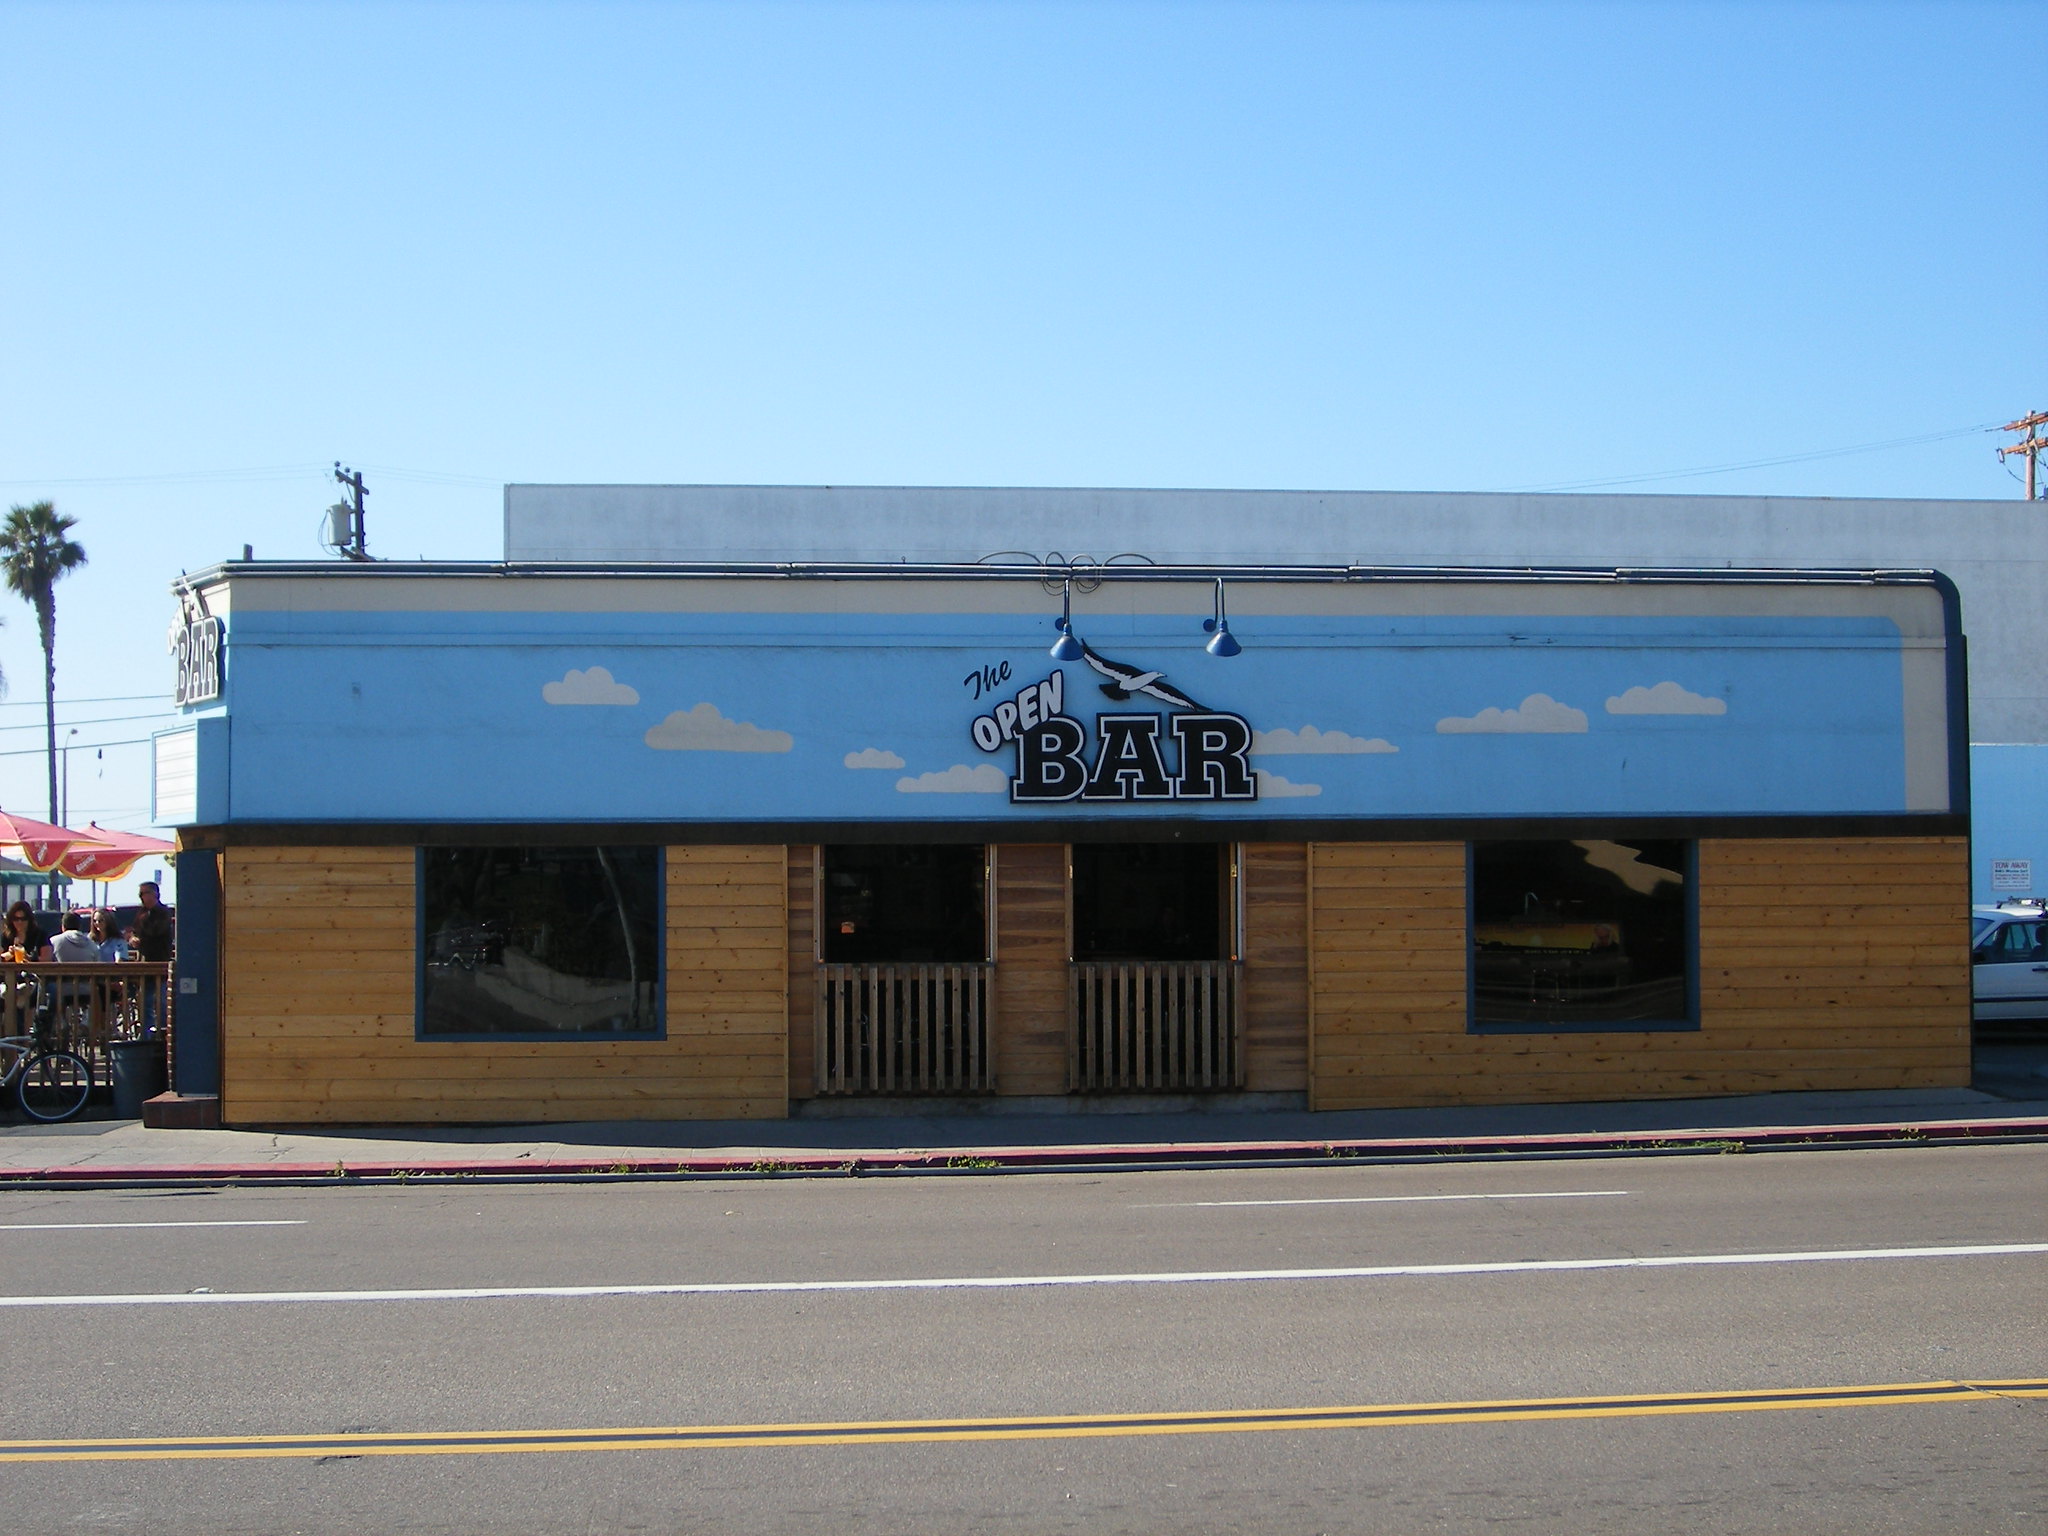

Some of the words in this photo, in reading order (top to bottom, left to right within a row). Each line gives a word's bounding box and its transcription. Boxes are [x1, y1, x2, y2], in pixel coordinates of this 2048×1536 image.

[175, 616, 218, 707] BAR
[964, 660, 1012, 700] The
[972, 670, 1064, 752] OPEN
[1010, 712, 1258, 803] BAR
